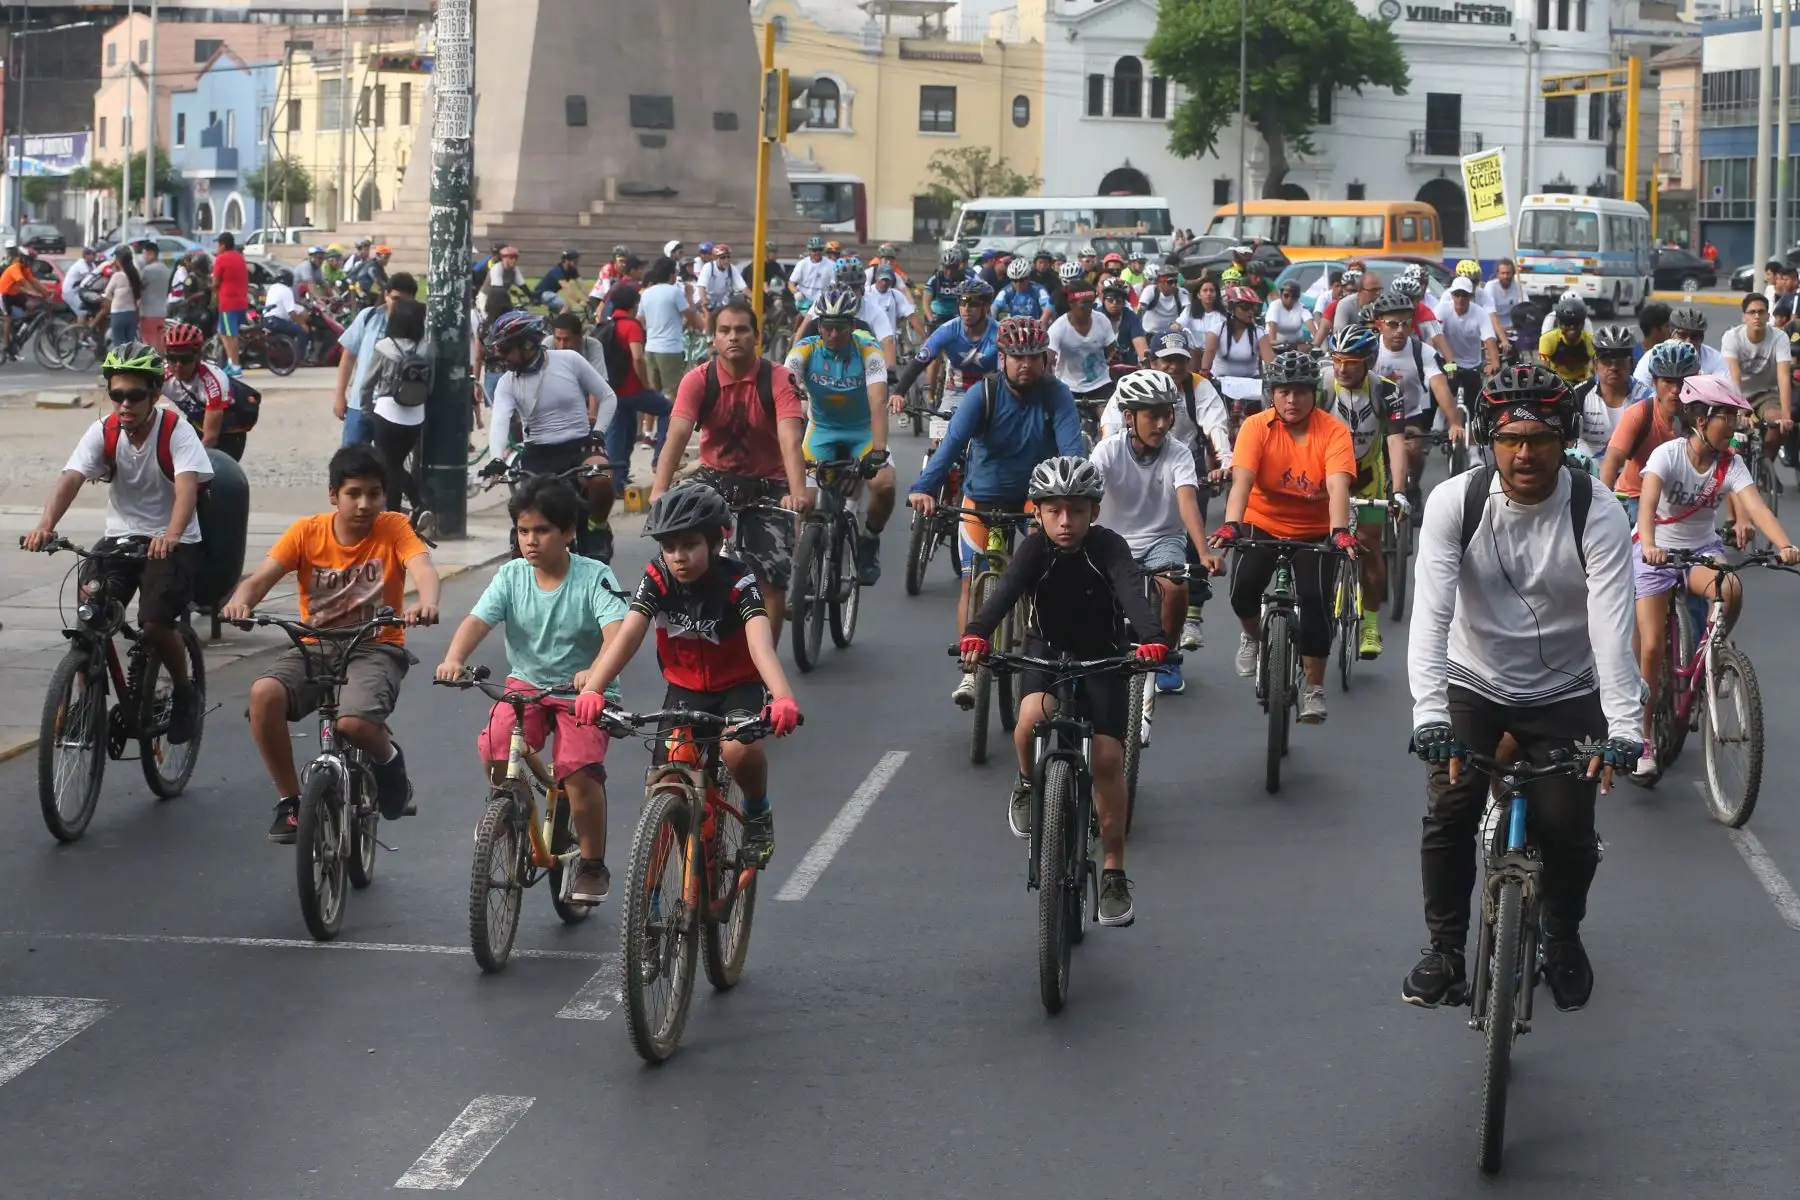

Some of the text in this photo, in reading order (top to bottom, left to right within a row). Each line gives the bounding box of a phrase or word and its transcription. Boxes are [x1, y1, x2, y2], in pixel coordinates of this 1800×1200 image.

[1406, 5, 1512, 25] Villarreal
[439, 17, 466, 33] 791618
[438, 61, 453, 69] CON
[437, 112, 452, 120] CON
[1467, 160, 1493, 175] RESPETA
